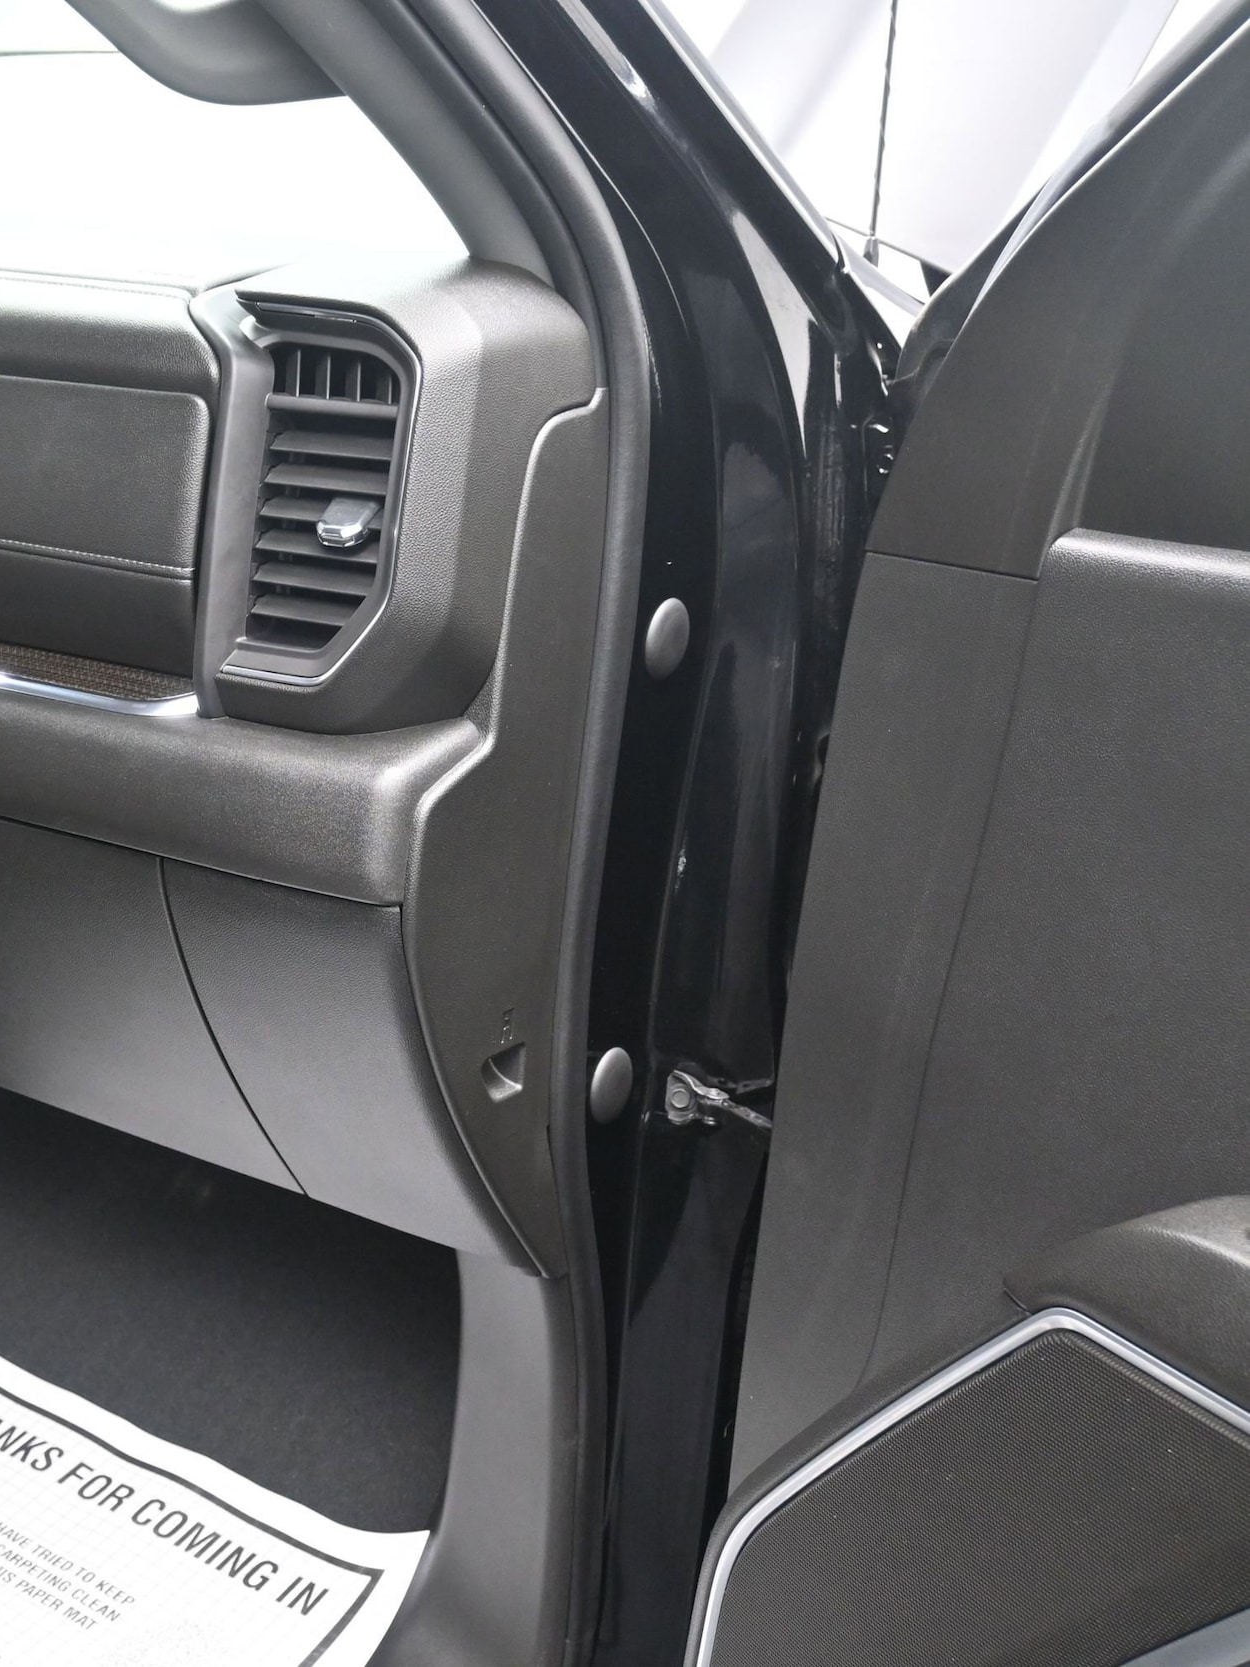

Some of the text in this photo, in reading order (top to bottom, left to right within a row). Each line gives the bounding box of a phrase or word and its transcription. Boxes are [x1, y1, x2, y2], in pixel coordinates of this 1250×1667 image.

[57, 1462, 135, 1512] FOR
[131, 1498, 279, 1591] COMING
[276, 1576, 329, 1616] IN
[32, 1544, 74, 1572] TRIED
[74, 1567, 96, 1583] TO
[95, 1579, 136, 1606] KEEP
[15, 1579, 64, 1611] PAPER
[63, 1606, 98, 1631] MAT
[71, 1588, 121, 1622] CLEAN
